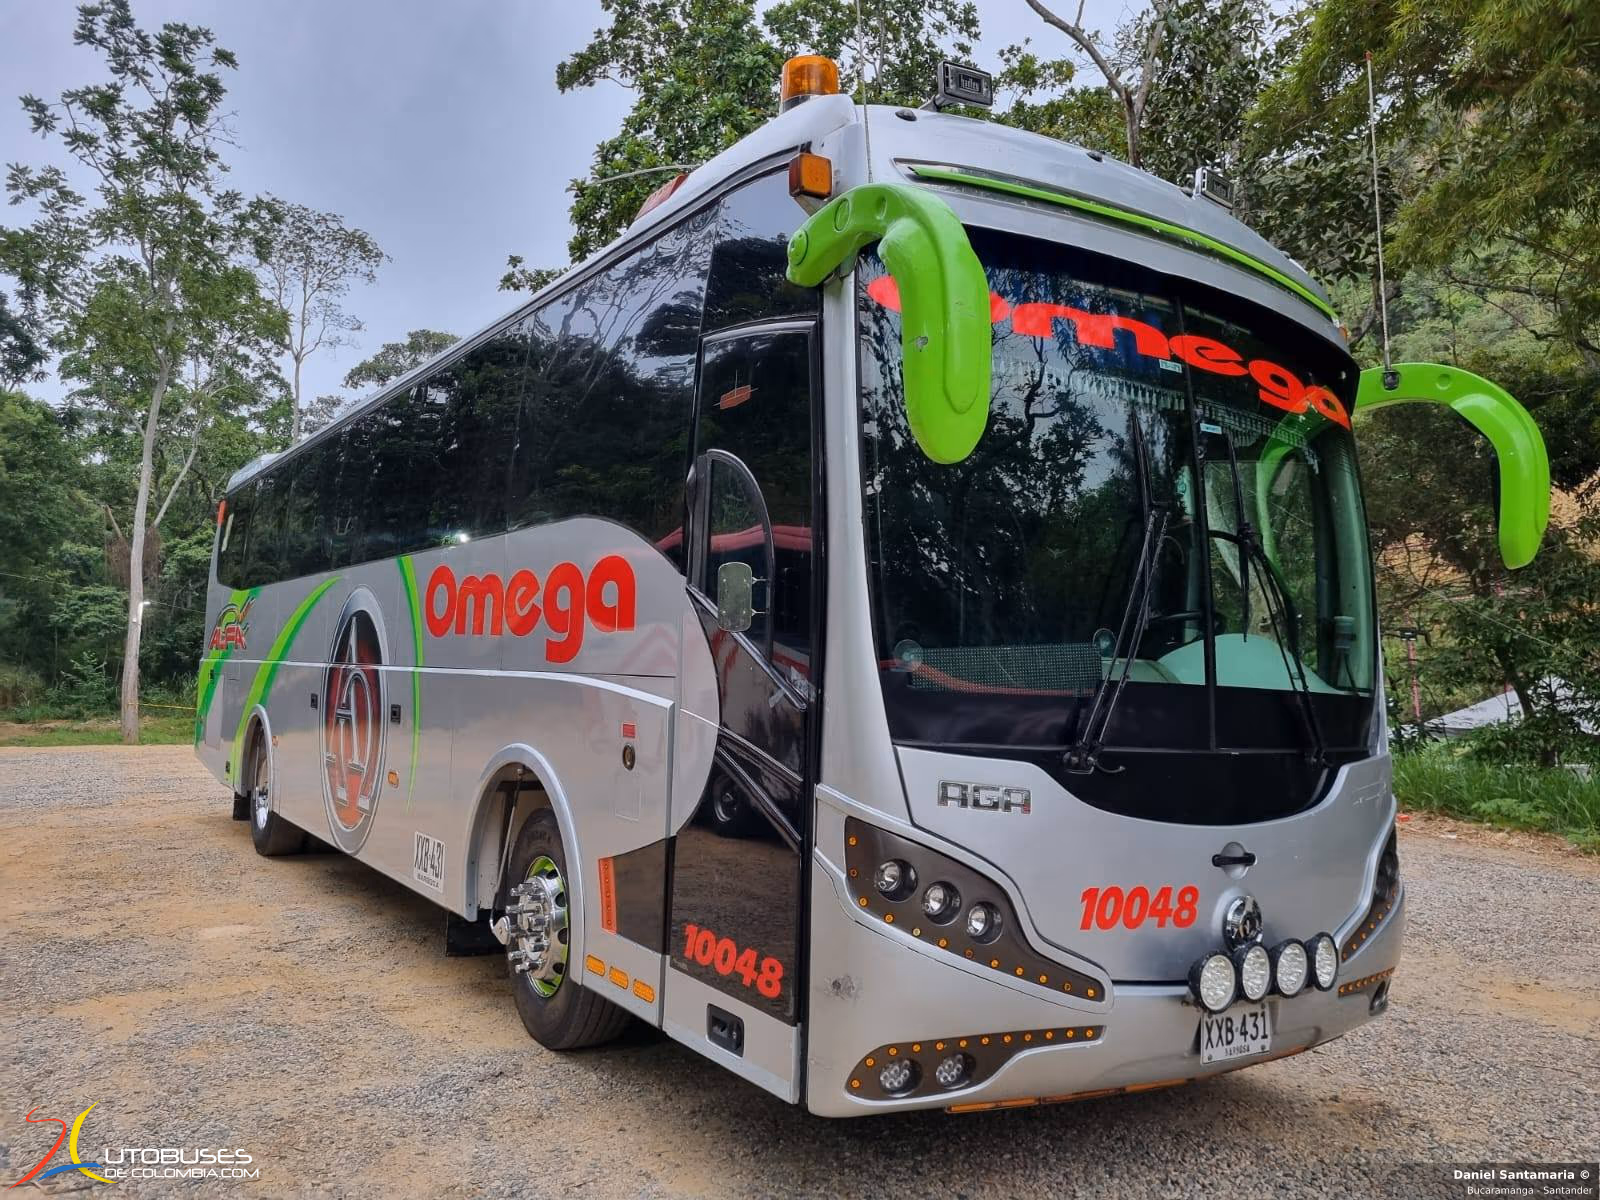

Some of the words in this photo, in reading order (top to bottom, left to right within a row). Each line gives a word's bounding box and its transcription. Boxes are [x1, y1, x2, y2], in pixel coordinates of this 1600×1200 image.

[938, 780, 1031, 815] AGA
[1079, 885, 1200, 931] 10048
[683, 923, 784, 999] 10048
